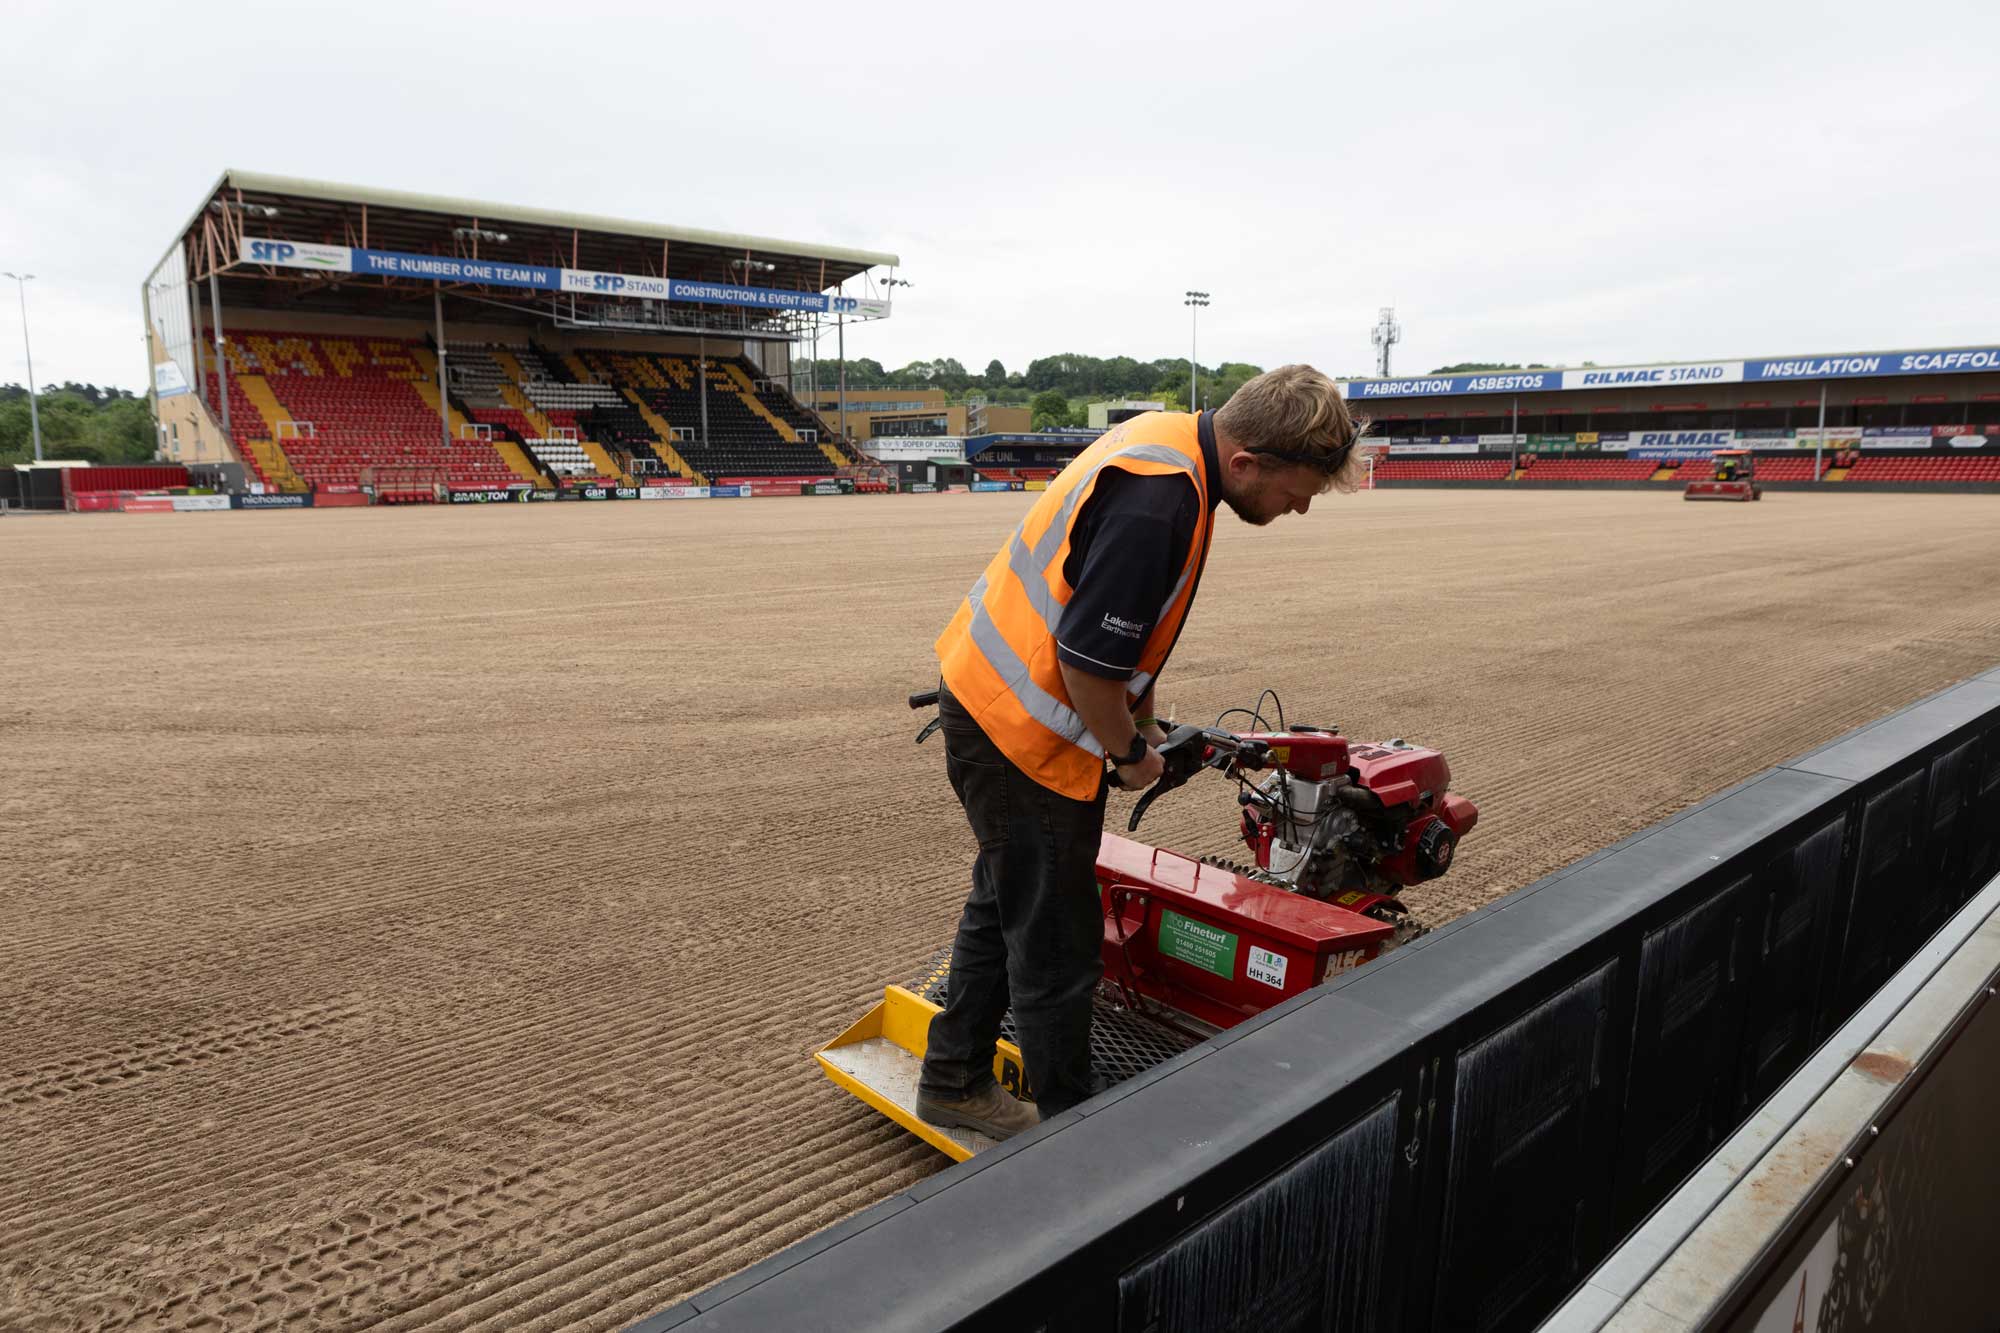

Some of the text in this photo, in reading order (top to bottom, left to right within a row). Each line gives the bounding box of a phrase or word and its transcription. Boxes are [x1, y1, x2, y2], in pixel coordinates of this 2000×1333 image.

[367, 255, 547, 284] THE NUMBER ONE TEAM IN
[568, 274, 591, 287] THE
[626, 280, 664, 293] STAND
[674, 284, 824, 308] CONSTRUCTION & EVENT HIRE
[1583, 366, 1724, 385] RILMAC STAND
[1761, 357, 1881, 378] INSULATION
[1363, 375, 1544, 395] FABRICATION ASBESTOS
[902, 440, 925, 448] SOPER
[925, 440, 933, 448] OF
[1640, 432, 1730, 446] RILMAC
[1638, 449, 1713, 458] www.rilmac.co
[242, 495, 303, 504] nicholsons
[453, 491, 509, 503] BRANSTON
[585, 489, 607, 497] GBM
[616, 488, 637, 496] GBM
[1103, 612, 1144, 632] Lakeland
[1184, 921, 1227, 944] Fineturf
[1248, 967, 1283, 987] HH 364
